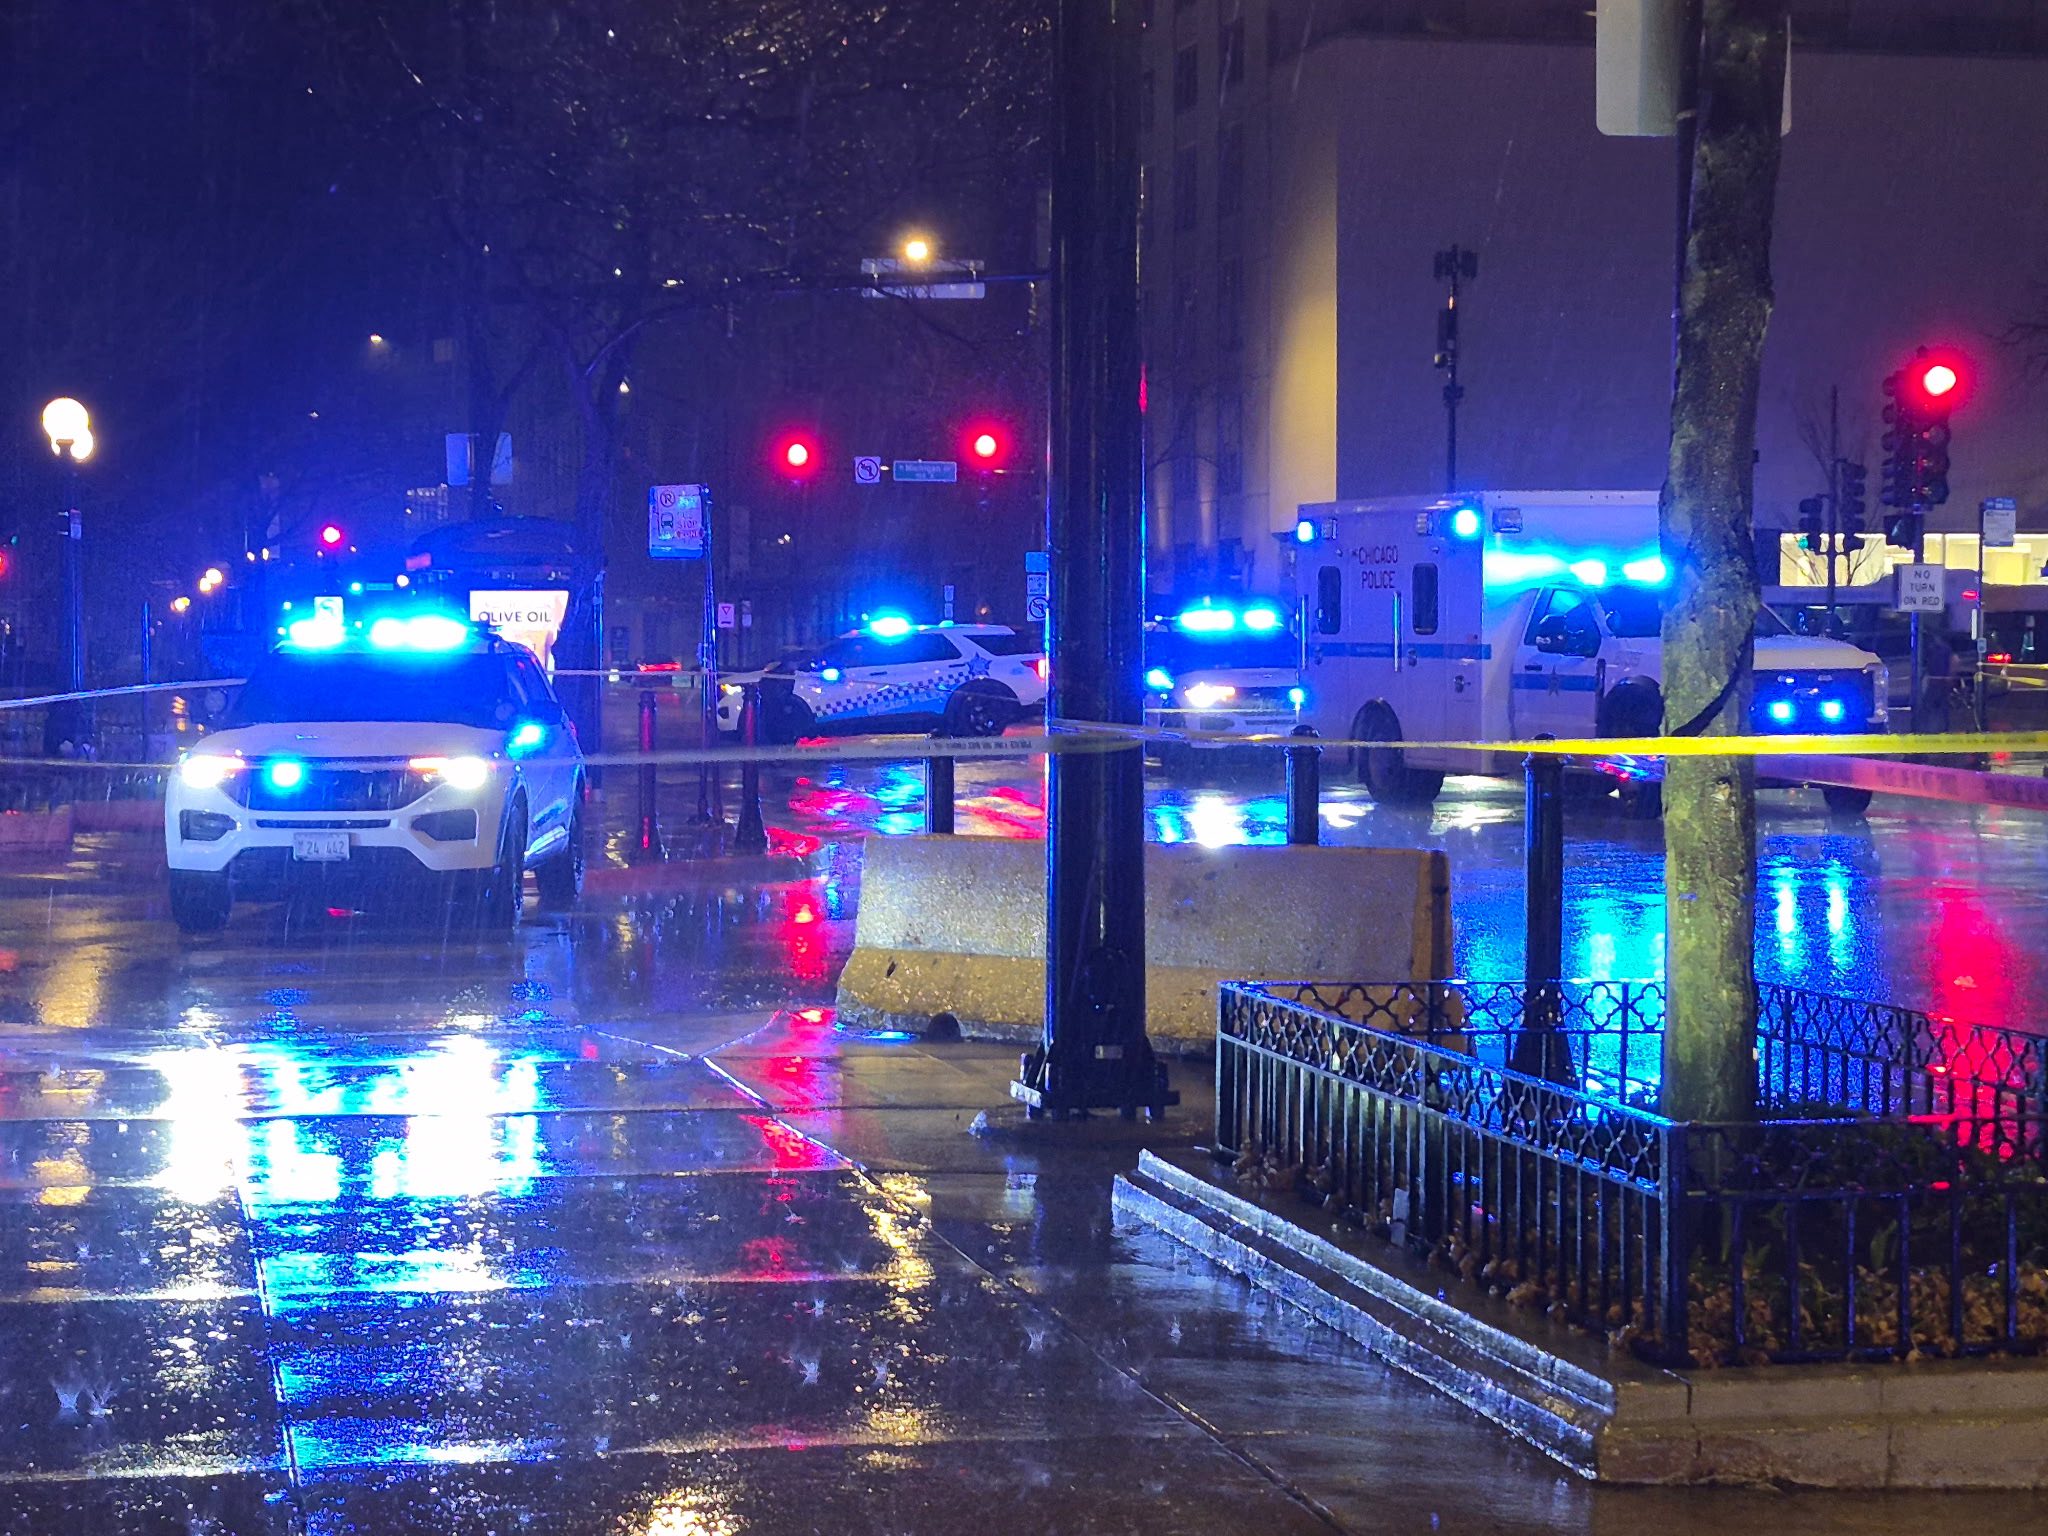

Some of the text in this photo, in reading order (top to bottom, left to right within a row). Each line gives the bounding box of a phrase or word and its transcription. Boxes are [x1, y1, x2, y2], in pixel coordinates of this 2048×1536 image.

[1358, 545, 1399, 565] CHICAGO
[1361, 570, 1396, 589] POLICE
[1914, 570, 1930, 579] NO
[1910, 583, 1936, 592] TURN
[1903, 596, 1940, 605] ON RED
[478, 611, 552, 622] OLIVE OIL
